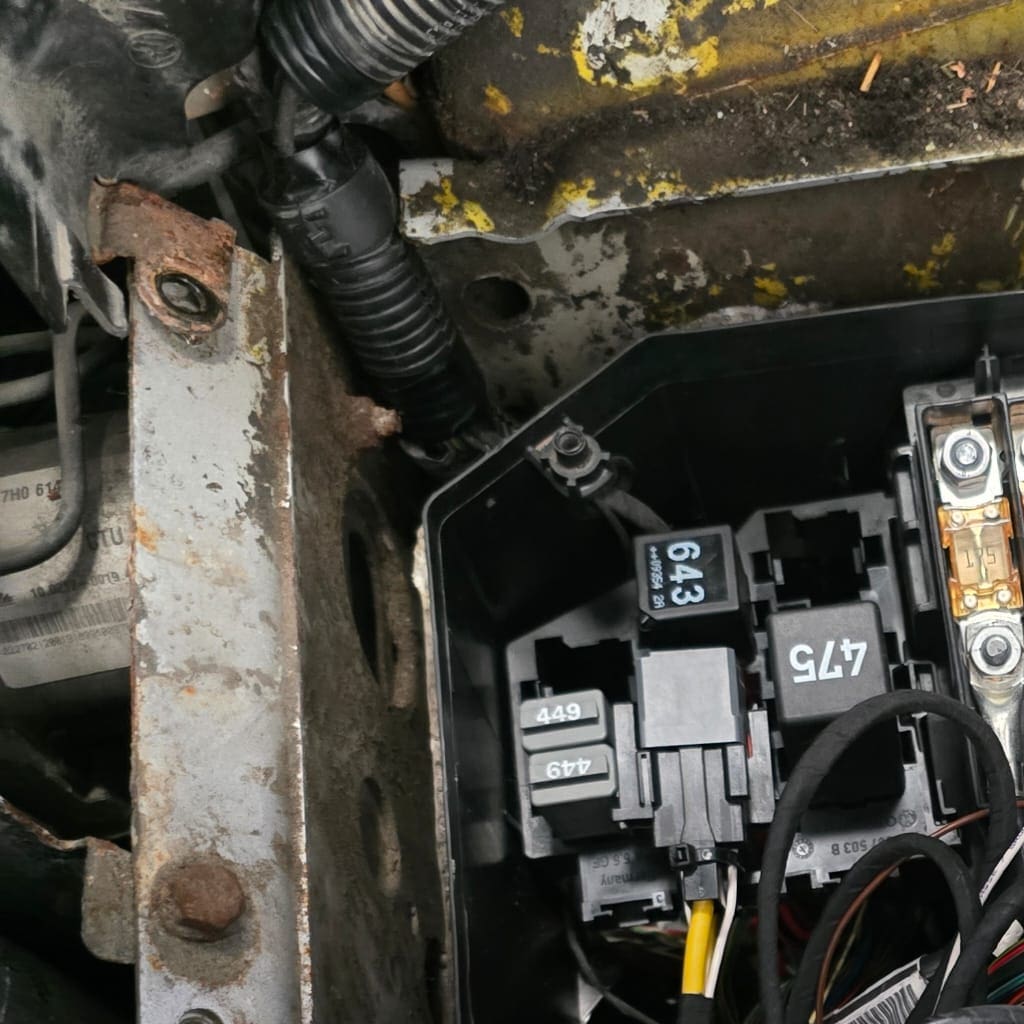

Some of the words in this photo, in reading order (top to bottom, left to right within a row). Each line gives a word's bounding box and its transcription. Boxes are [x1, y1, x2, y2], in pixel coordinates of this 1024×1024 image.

[1, 486, 29, 502] 7H0
[667, 541, 705, 606] 643
[790, 638, 868, 683] 475
[536, 703, 582, 725] 449
[546, 757, 592, 780] 449
